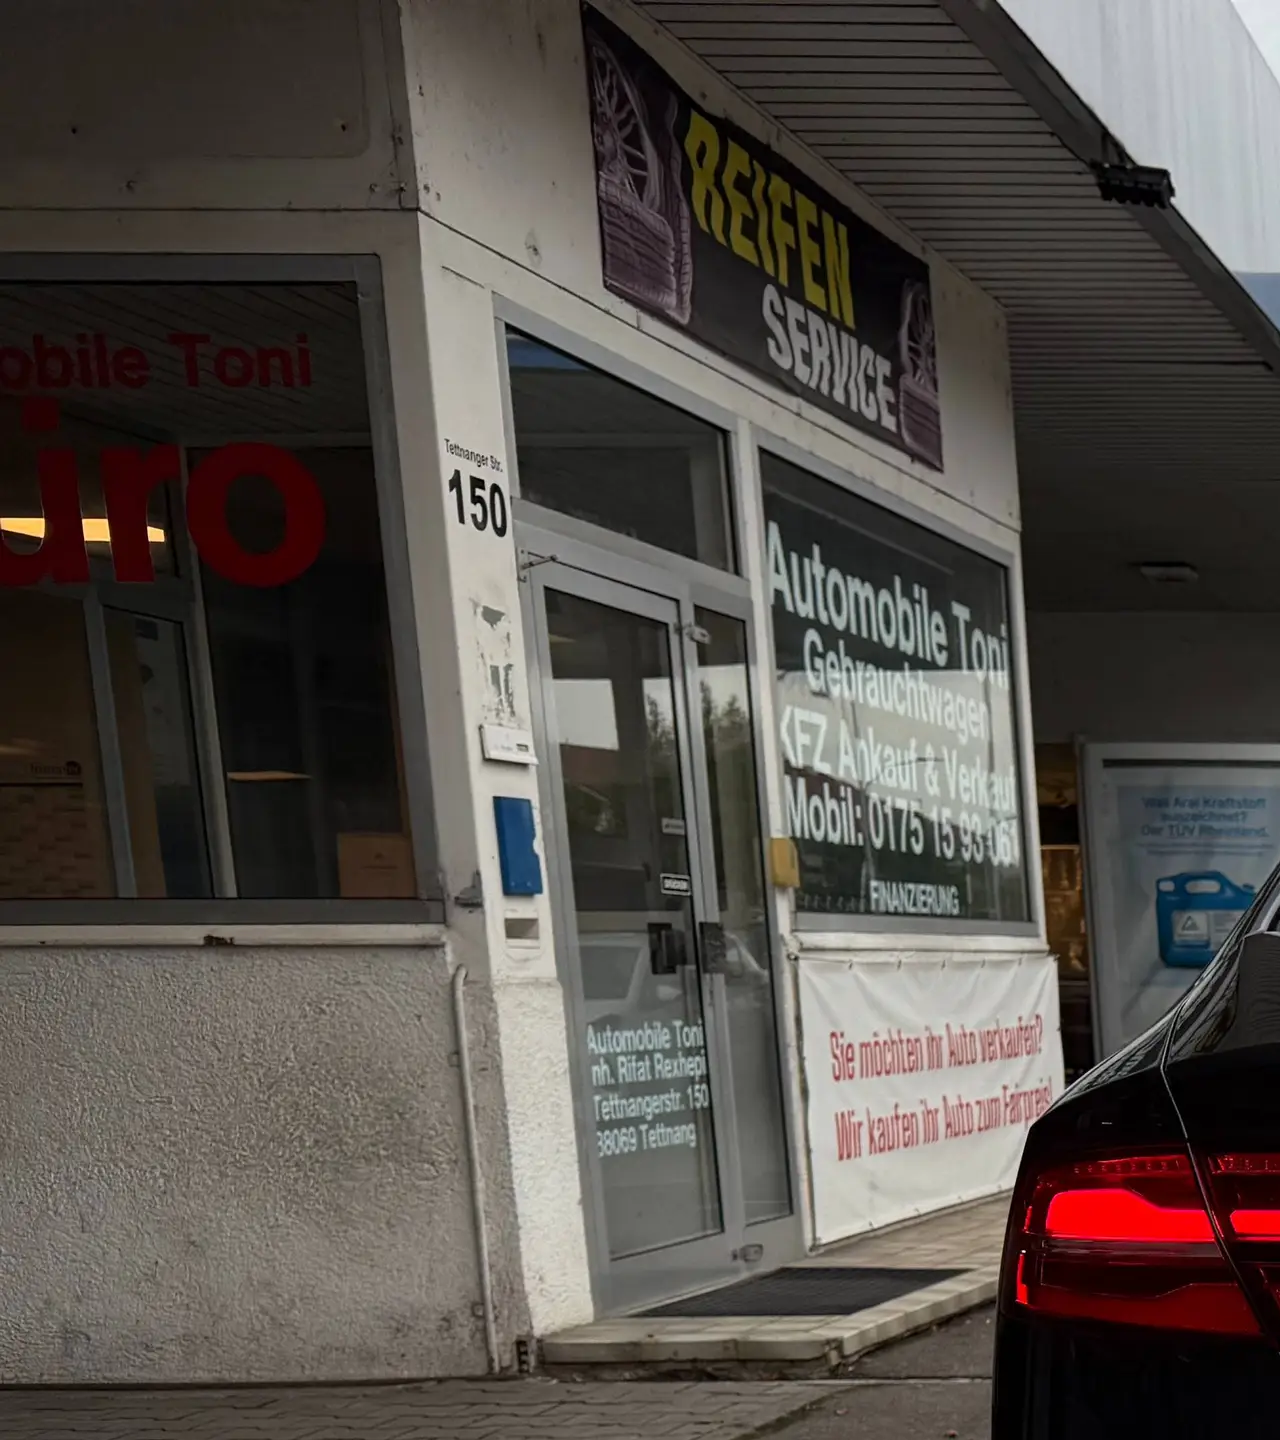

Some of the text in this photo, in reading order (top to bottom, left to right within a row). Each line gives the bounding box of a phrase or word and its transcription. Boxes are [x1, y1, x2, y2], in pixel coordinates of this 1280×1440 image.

[684, 109, 856, 330] REIFEN
[168, 332, 313, 389] Toni
[761, 283, 898, 433] SERVICE
[444, 438, 503, 472] Tettnanger Str.
[448, 469, 507, 538] 150
[768, 520, 1008, 690] Automobile Toni
[804, 628, 988, 746] Gebrauchtwagen
[838, 718, 918, 793] Ankauf
[924, 742, 940, 797] &
[943, 747, 1017, 813] Verkauf
[785, 773, 864, 847] Mobil:
[868, 791, 924, 855] 0175
[932, 805, 955, 859] 15
[960, 811, 984, 864] 93
[870, 879, 960, 916] FINANZIERUNG
[587, 1017, 704, 1055] Automobile Toni
[617, 1053, 652, 1084] Rifat
[653, 1048, 707, 1081] Rexhepi
[829, 1030, 855, 1082] Sie
[859, 1028, 923, 1079] möchten
[946, 1022, 977, 1068] Auto
[979, 1013, 1044, 1064] verkaufen?
[593, 1083, 709, 1120] Tettnangerstr. 150
[639, 1122, 697, 1150] Tettnang
[834, 1109, 864, 1161] Wir
[866, 1102, 920, 1155] kaufen
[920, 1099, 940, 1145] ihr
[942, 1092, 975, 1139] Auto
[975, 1097, 1001, 1132] zum
